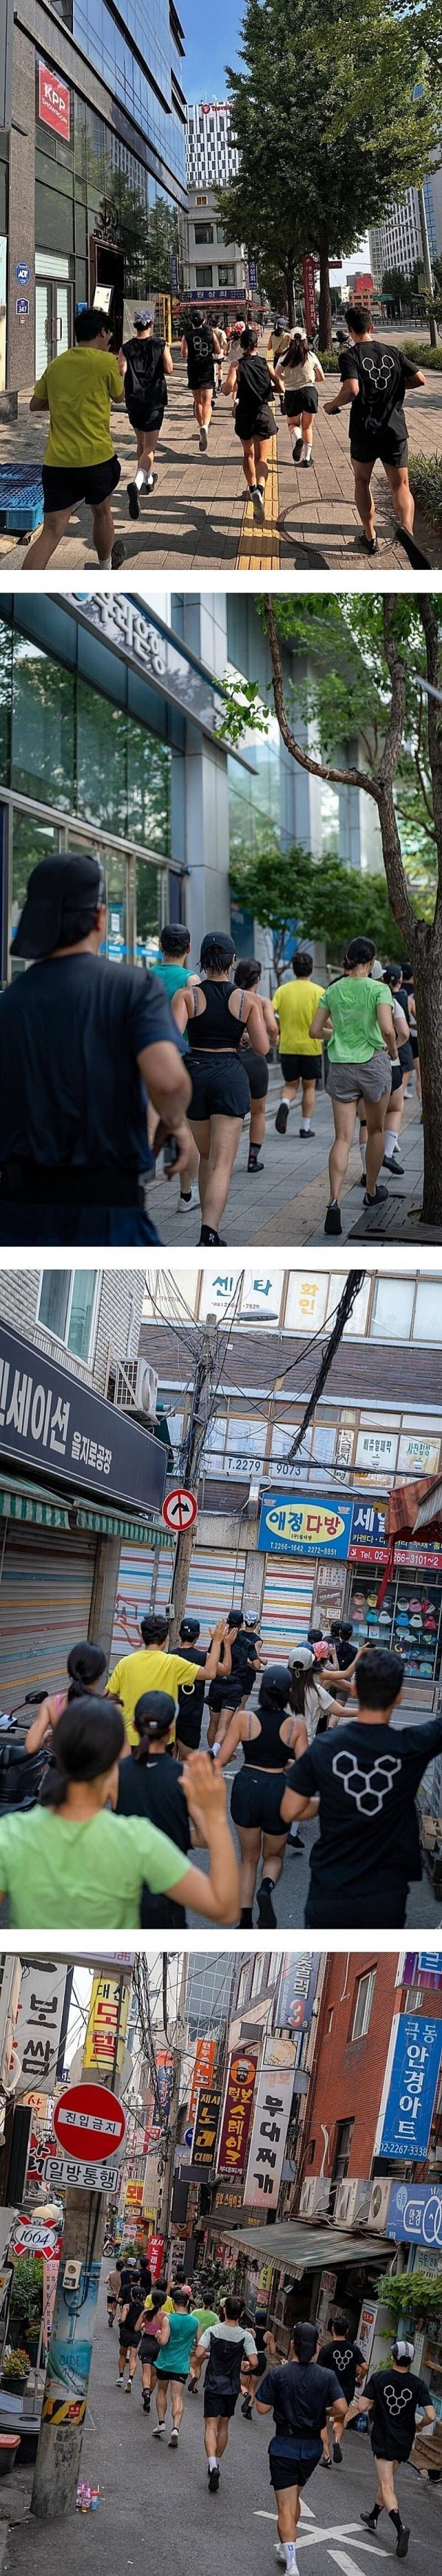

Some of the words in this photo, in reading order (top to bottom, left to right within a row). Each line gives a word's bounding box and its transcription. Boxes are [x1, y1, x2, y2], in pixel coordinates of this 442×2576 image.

[43, 82, 66, 110] KPP
[41, 97, 68, 124] SHOWROOM
[18, 270, 28, 278] ADT
[190, 291, 228, 299] 원상회
[94, 593, 166, 675] 우리은행
[298, 1284, 318, 1315] 화인
[71, 1431, 112, 1474] 을지로공장
[407, 1443, 431, 1456] 사진합성
[360, 1551, 372, 1560] Tel.
[374, 1551, 439, 1566] 02-266-3101~2
[97, 1984, 125, 2003] 대신
[22, 1993, 58, 2076] 보쌈
[92, 2002, 122, 2058] 모텔
[404, 2021, 438, 2044] 극동
[200, 2094, 221, 2106] 제시
[228, 2087, 253, 2104] 털보
[393, 2045, 429, 2141] 안경아트
[66, 2111, 116, 2134] 진입금지
[224, 2105, 247, 2165] 스테이크
[253, 2095, 284, 2195] 부대찌개
[194, 2152, 213, 2163] CLUB
[49, 2161, 115, 2189] 일방통행
[409, 2208, 422, 2227] 안경
[20, 2230, 51, 2245] 1664
